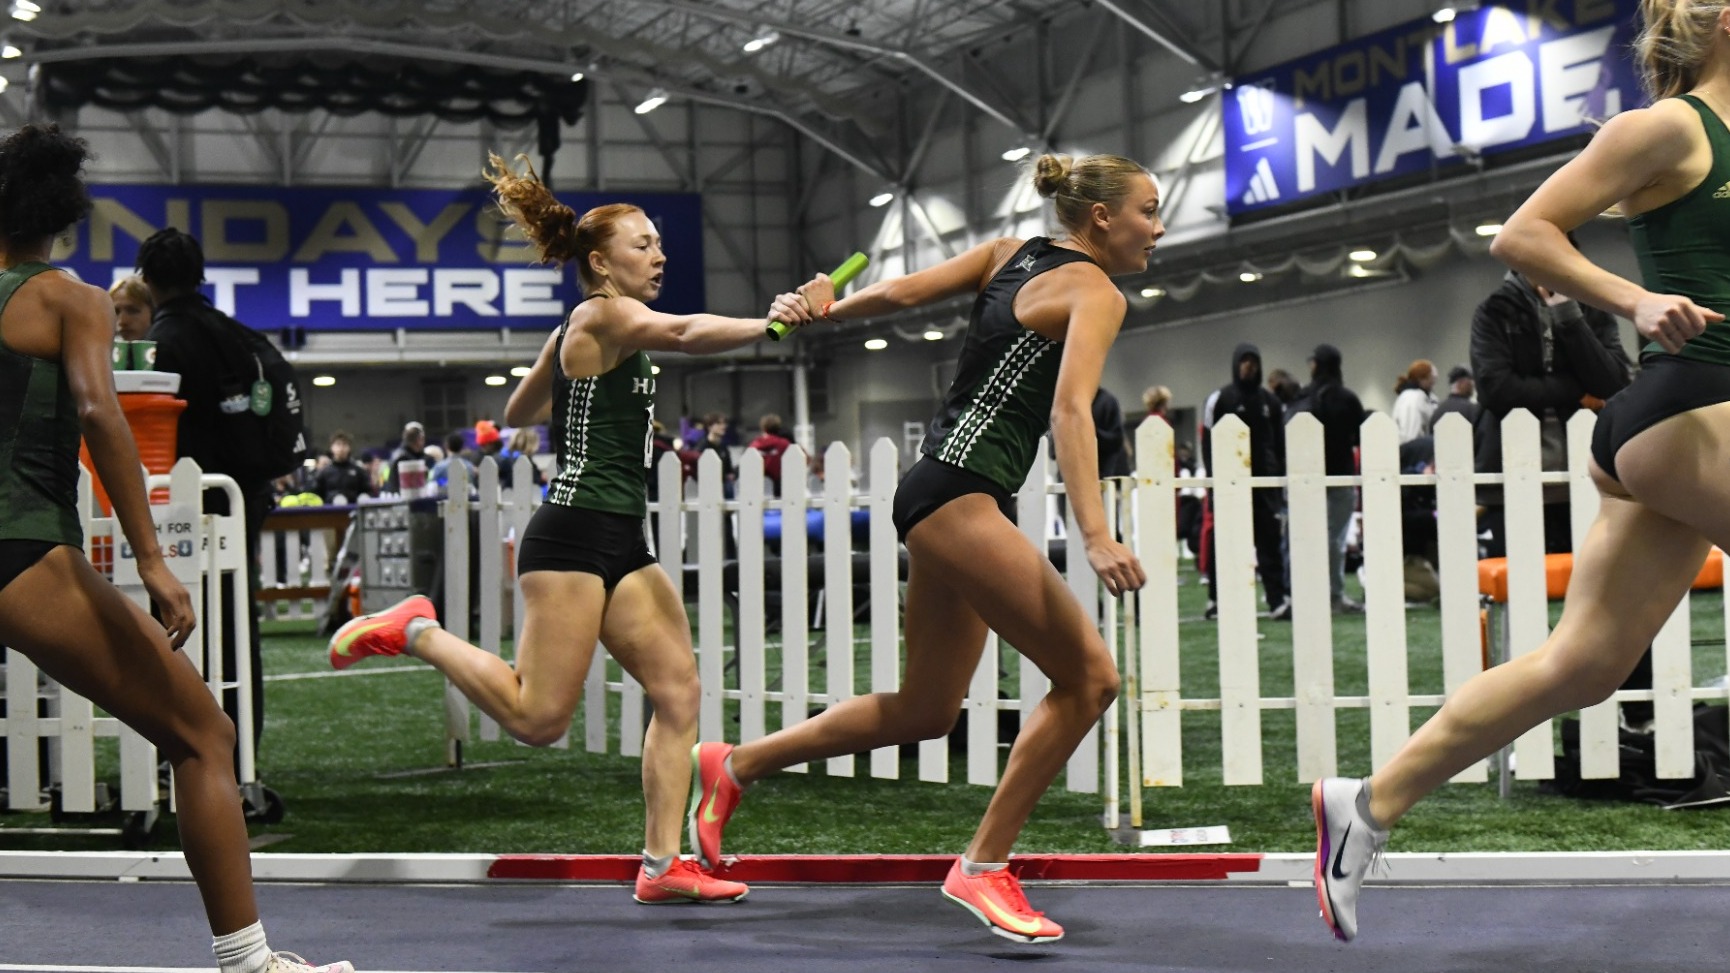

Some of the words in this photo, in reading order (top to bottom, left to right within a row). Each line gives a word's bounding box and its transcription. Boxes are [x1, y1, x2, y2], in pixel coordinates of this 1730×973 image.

[1294, 0, 1615, 107] MONTLAKE
[289, 268, 564, 317] HERE
[168, 523, 192, 534] FOR
